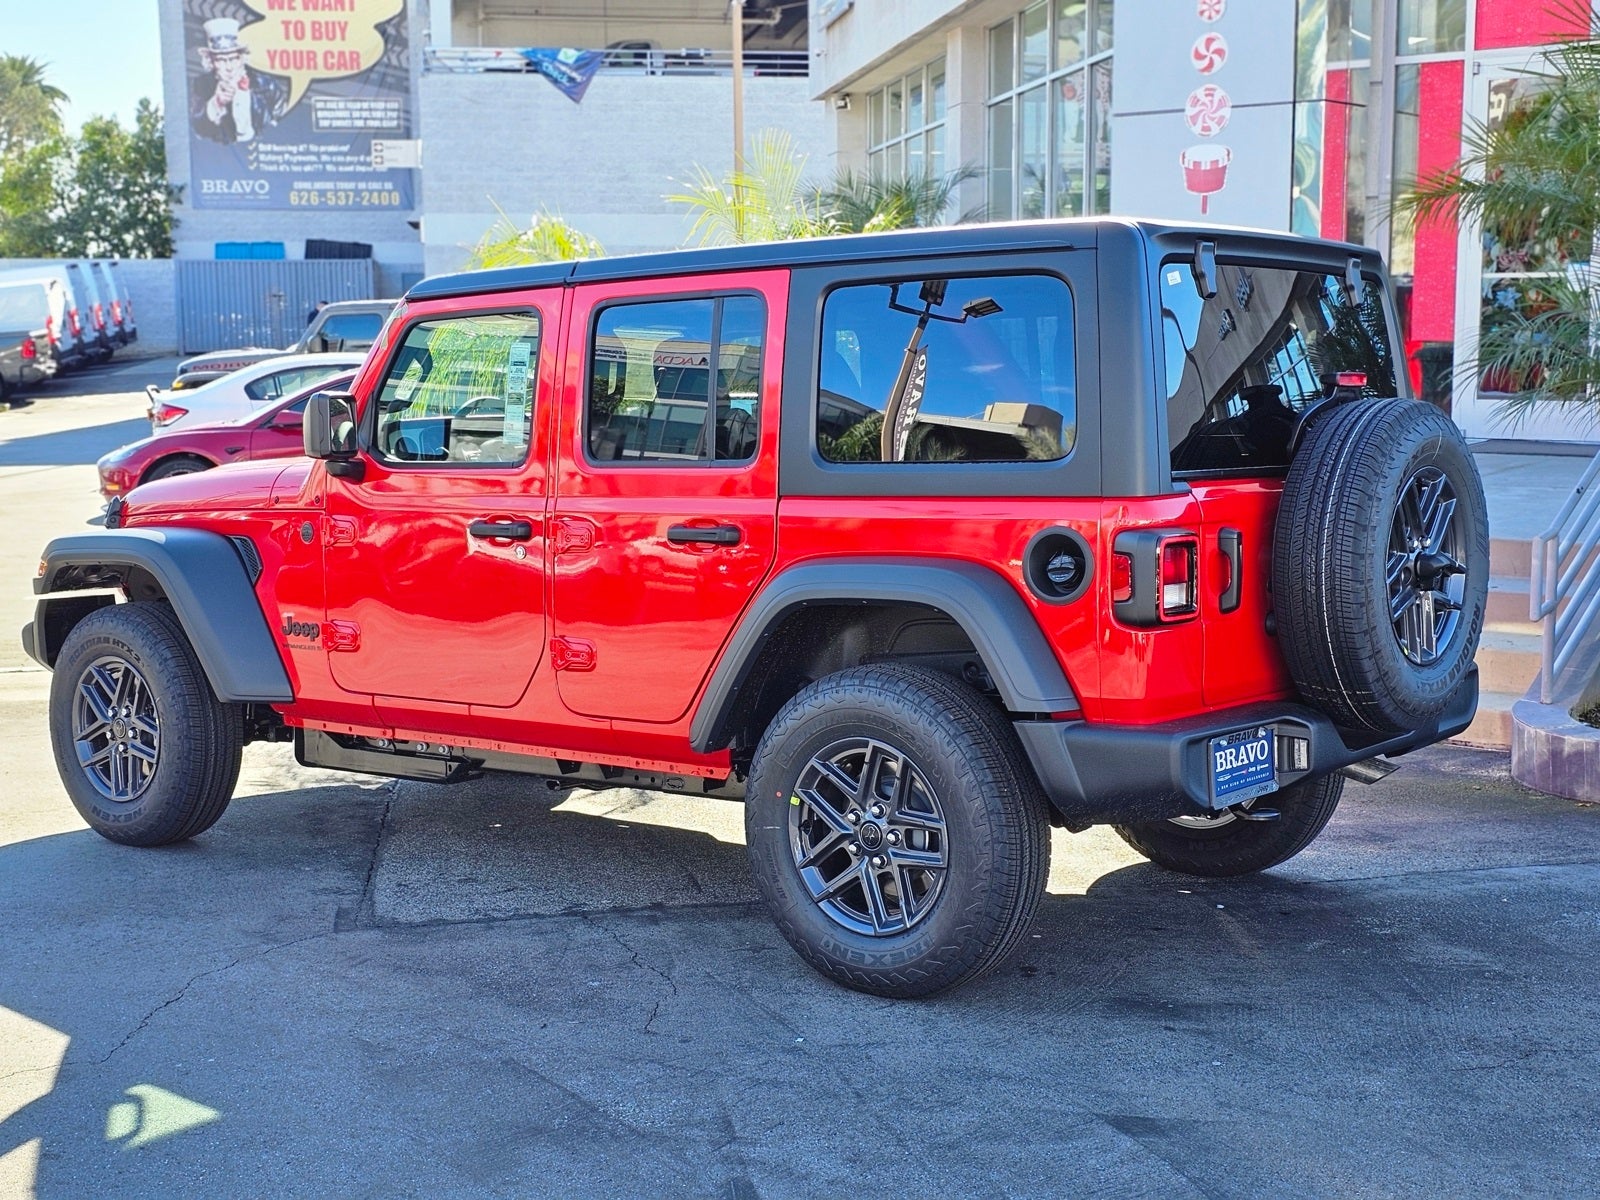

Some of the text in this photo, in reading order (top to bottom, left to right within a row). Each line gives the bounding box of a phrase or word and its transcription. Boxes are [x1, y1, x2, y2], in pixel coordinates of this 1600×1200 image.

[281, 20, 349, 41] TO BUY
[266, 50, 362, 71] YOUR CAR
[201, 179, 270, 194] BRAVO
[289, 191, 400, 206] 626-537-2400
[192, 361, 257, 371] MOJAV
[282, 615, 320, 642] Jeep
[1227, 728, 1260, 744] BRAVO
[1214, 739, 1269, 773] BRAVO
[91, 804, 143, 823] NEXEN
[831, 942, 923, 967] NEXEN
